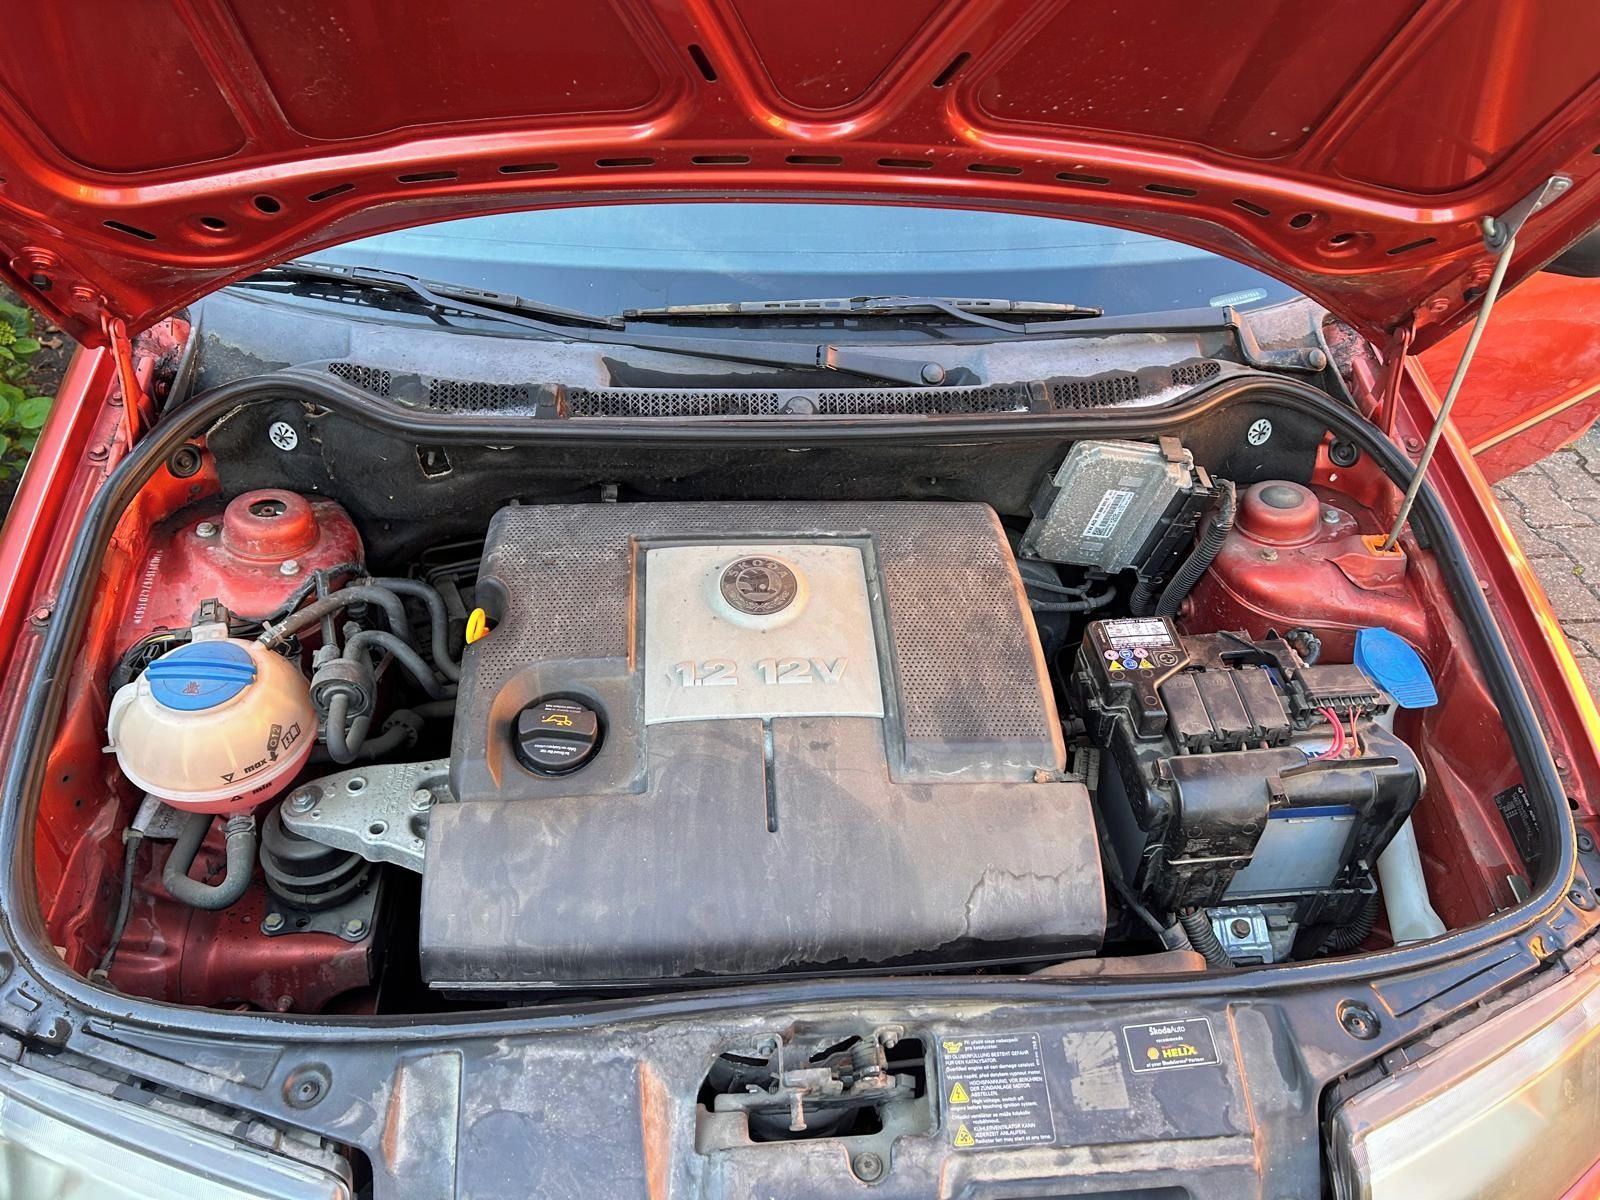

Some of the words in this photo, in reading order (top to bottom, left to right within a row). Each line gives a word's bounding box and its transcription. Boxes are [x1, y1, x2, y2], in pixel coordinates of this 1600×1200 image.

[675, 658, 738, 687] 1.2
[756, 656, 849, 685] 12V
[244, 758, 268, 774] max
[252, 782, 272, 794] min
[1162, 1046, 1198, 1058] HELIX
